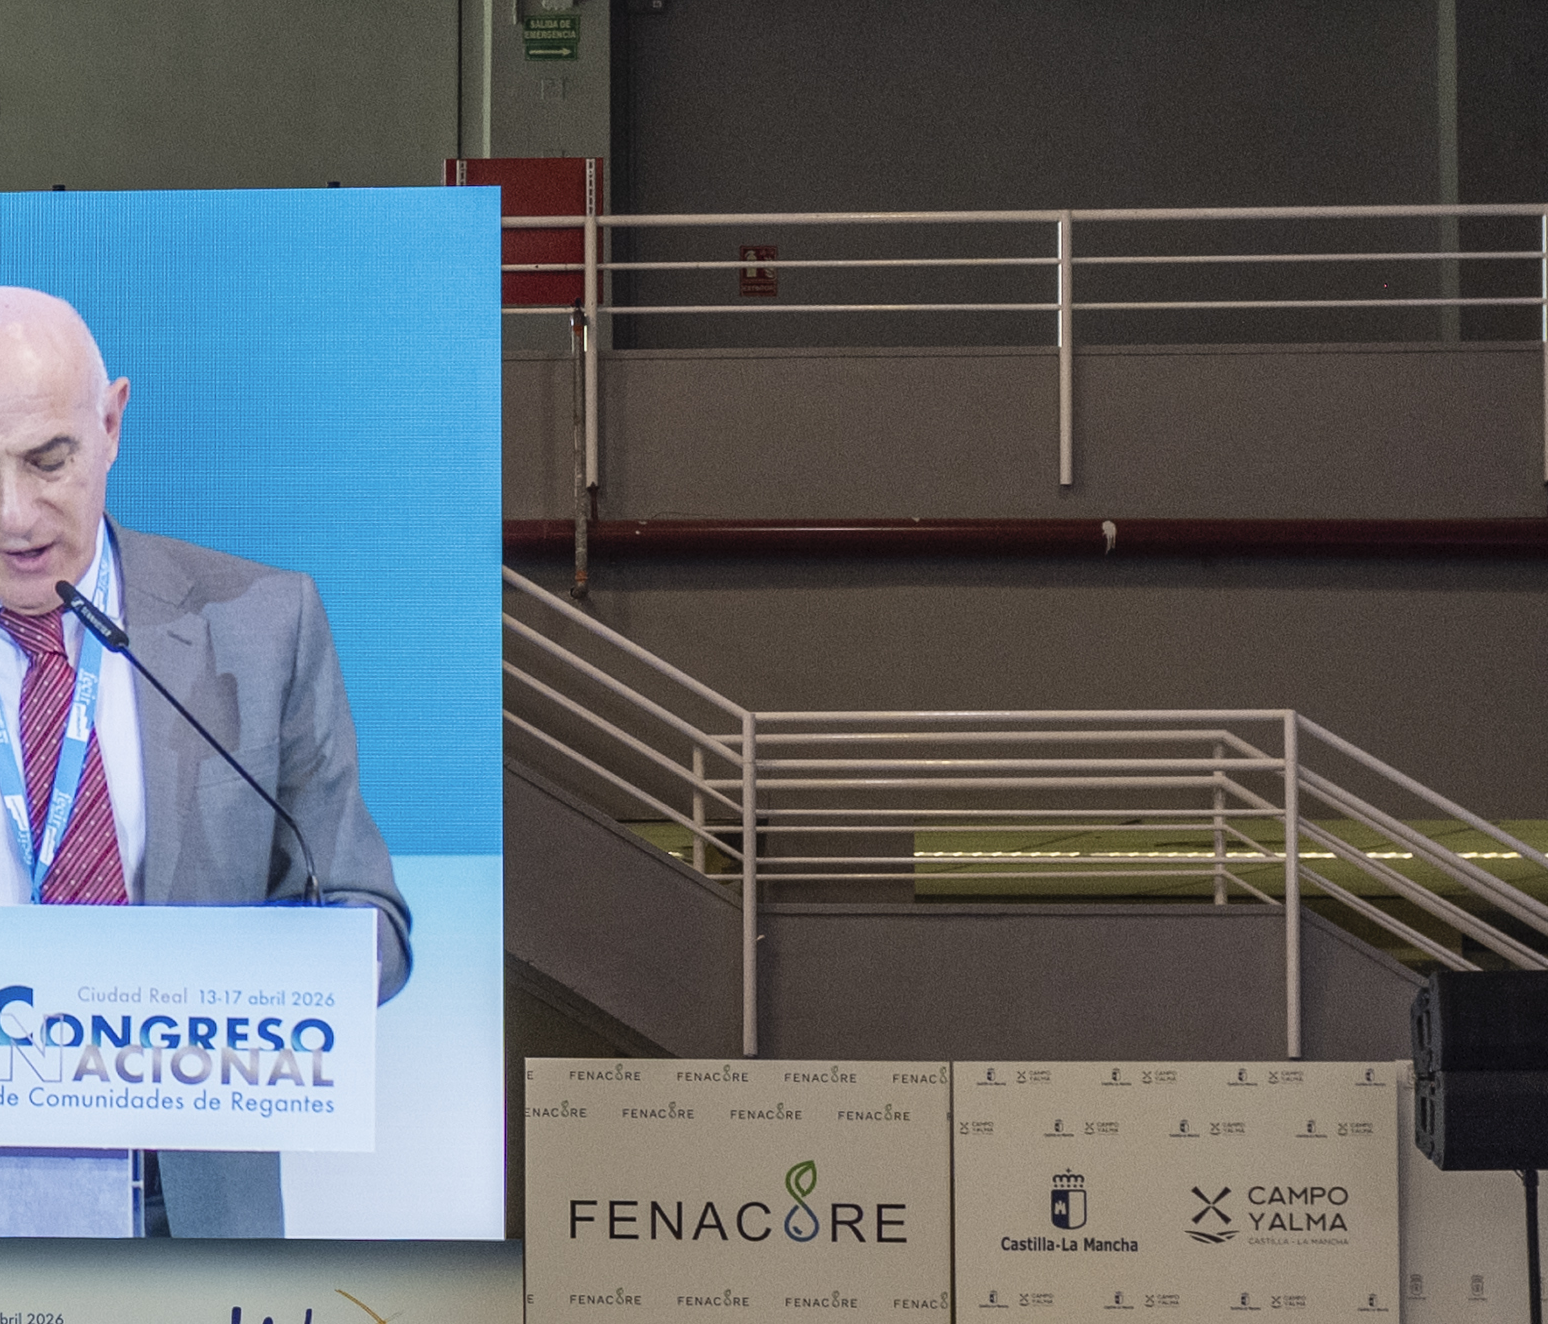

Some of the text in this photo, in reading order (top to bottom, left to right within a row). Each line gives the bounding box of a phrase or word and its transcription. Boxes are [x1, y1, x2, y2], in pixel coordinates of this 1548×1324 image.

[78, 986, 335, 1007] Ciudad Real 13-17 abril 2026
[570, 1067, 641, 1081] FENACORE
[29, 1087, 184, 1109] Comunidades
[194, 1090, 220, 1110] de
[231, 1091, 335, 1118] Regantes
[730, 1106, 802, 1120] FENACORE
[1248, 1186, 1348, 1205] CAMPO
[569, 1192, 908, 1244] FENACORE
[1249, 1213, 1347, 1231] YALMA
[1001, 1237, 1138, 1252] Castilla-La Mancha
[785, 1293, 857, 1308] FENACORE
